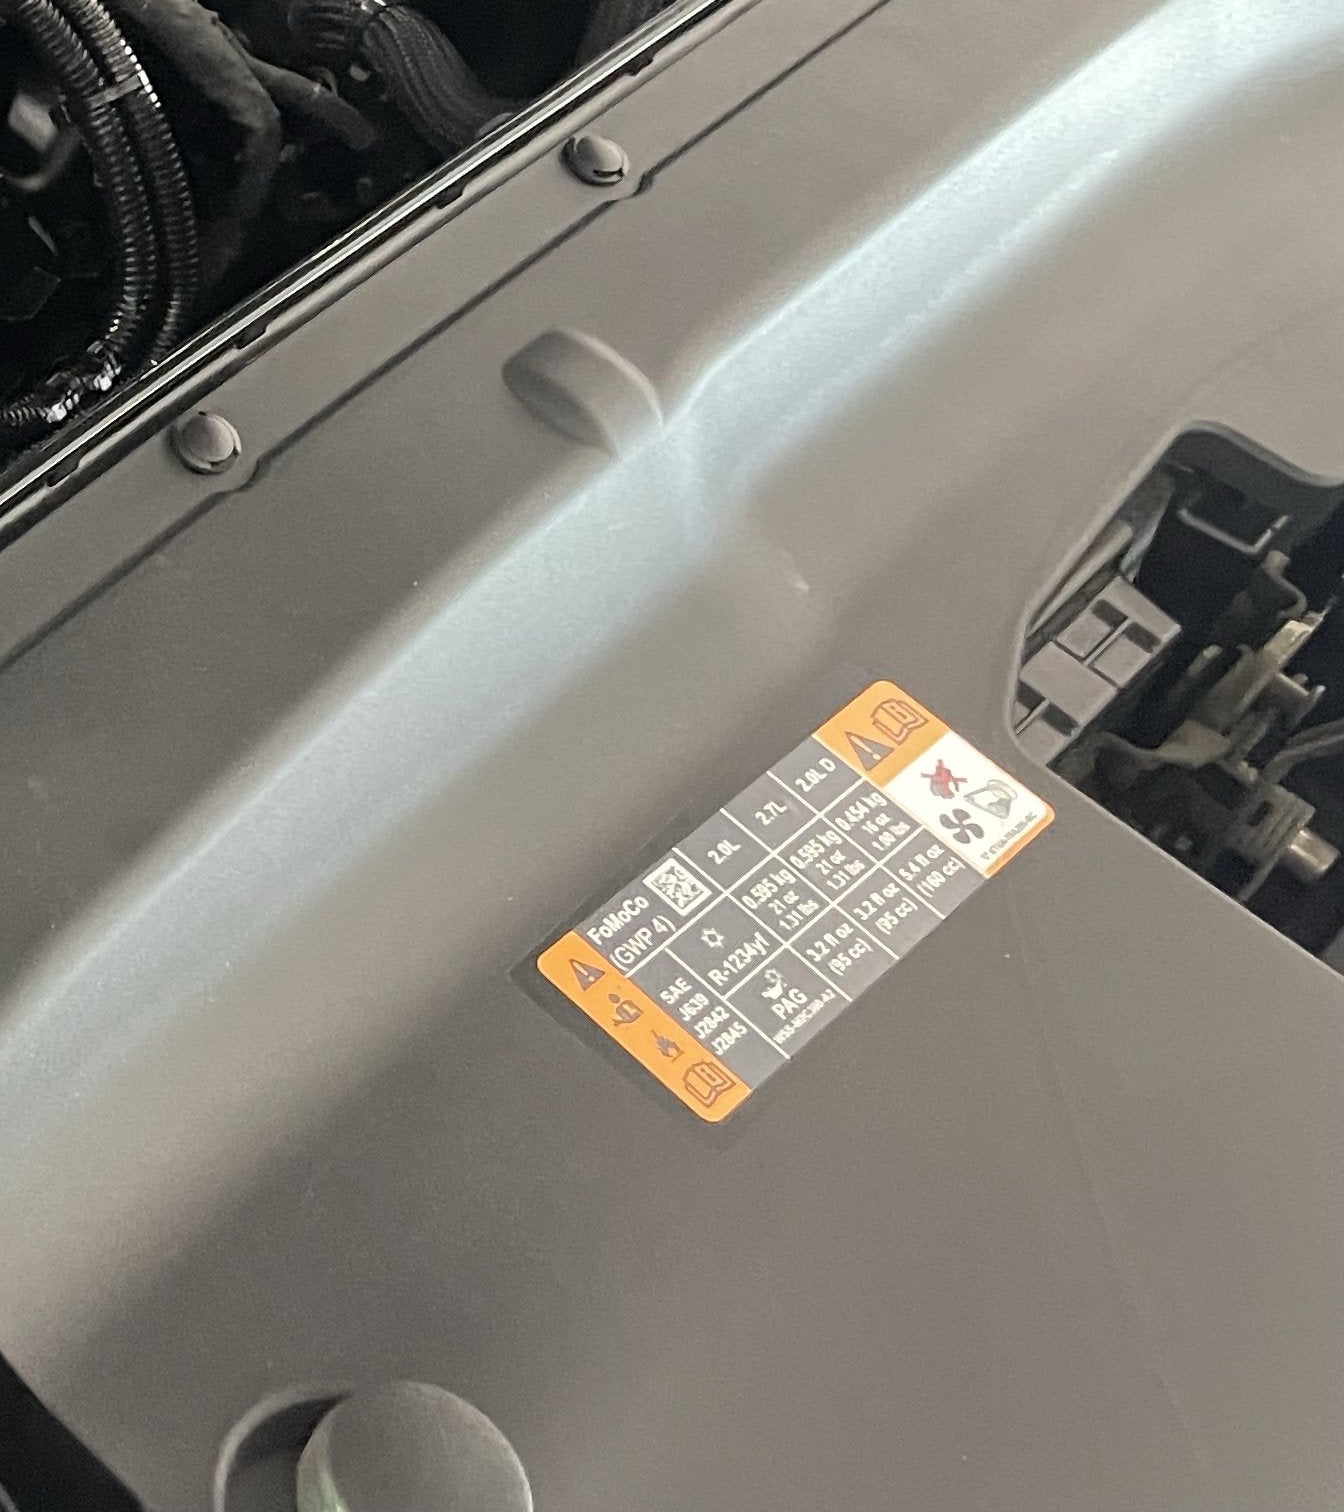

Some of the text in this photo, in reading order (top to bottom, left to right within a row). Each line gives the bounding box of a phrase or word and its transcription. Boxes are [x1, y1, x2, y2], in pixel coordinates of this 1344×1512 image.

[795, 758, 836, 792] 2.0L D
[755, 801, 787, 825] 2.7L
[862, 792, 888, 811] kg
[707, 840, 741, 865] 2.0L
[816, 830, 843, 847] kg
[769, 869, 796, 885] kg
[816, 859, 834, 875] 21
[898, 862, 921, 882] 5.4
[927, 844, 945, 859] oz
[768, 899, 786, 915] 21
[853, 900, 878, 921] 3.2
[882, 882, 900, 898] oz
[587, 896, 649, 946] FoMoCo
[609, 915, 677, 972] (GWP 4)
[806, 940, 830, 962] 3.2
[835, 922, 854, 938] oz
[708, 931, 770, 987] R-1234yf
[660, 976, 692, 1005] SAE
[771, 988, 807, 1020] PAG
[678, 993, 710, 1022] J639
[694, 1006, 730, 1039] J2842
[711, 1021, 748, 1056] J2845
